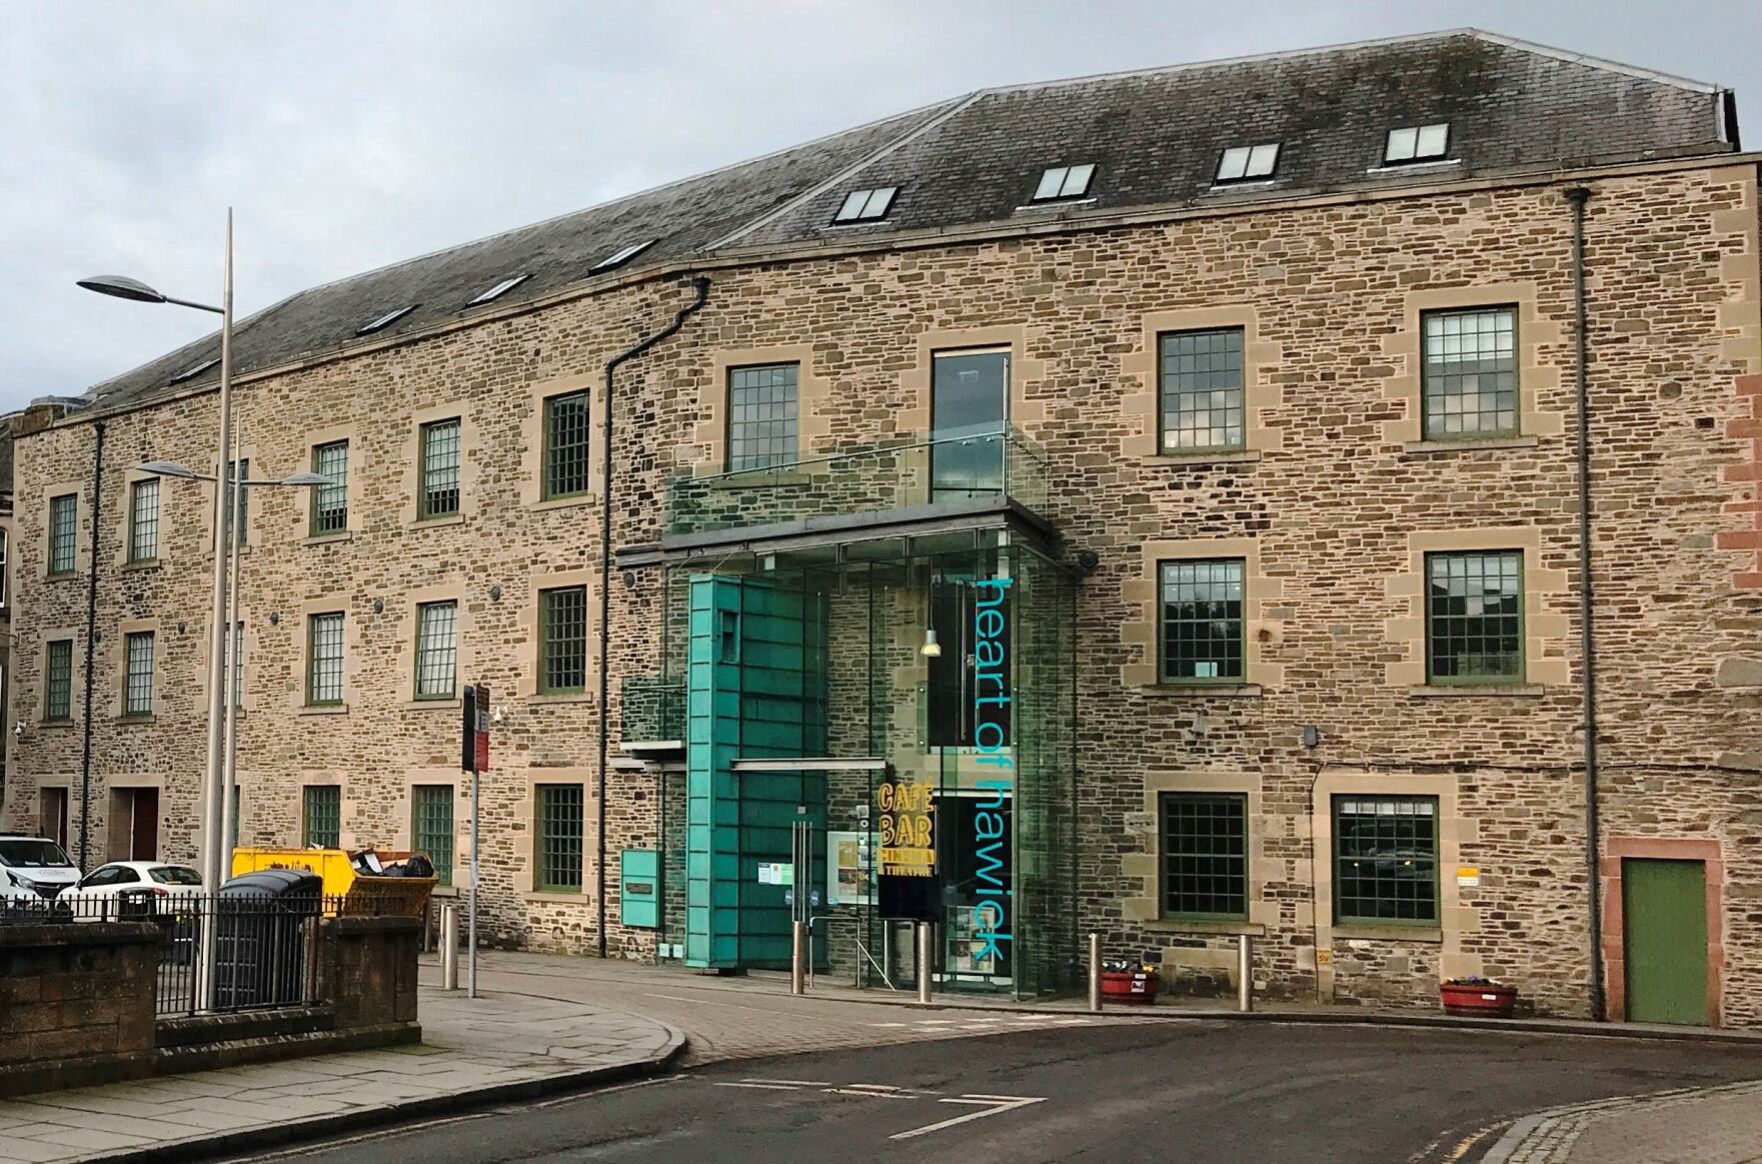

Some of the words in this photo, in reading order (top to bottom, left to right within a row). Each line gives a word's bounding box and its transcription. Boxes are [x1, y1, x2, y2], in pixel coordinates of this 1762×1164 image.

[976, 578, 1013, 709] heart
[975, 722, 1014, 768] of
[879, 814, 932, 847] BAR
[878, 849, 933, 863] CINA
[975, 780, 1013, 961] hawick
